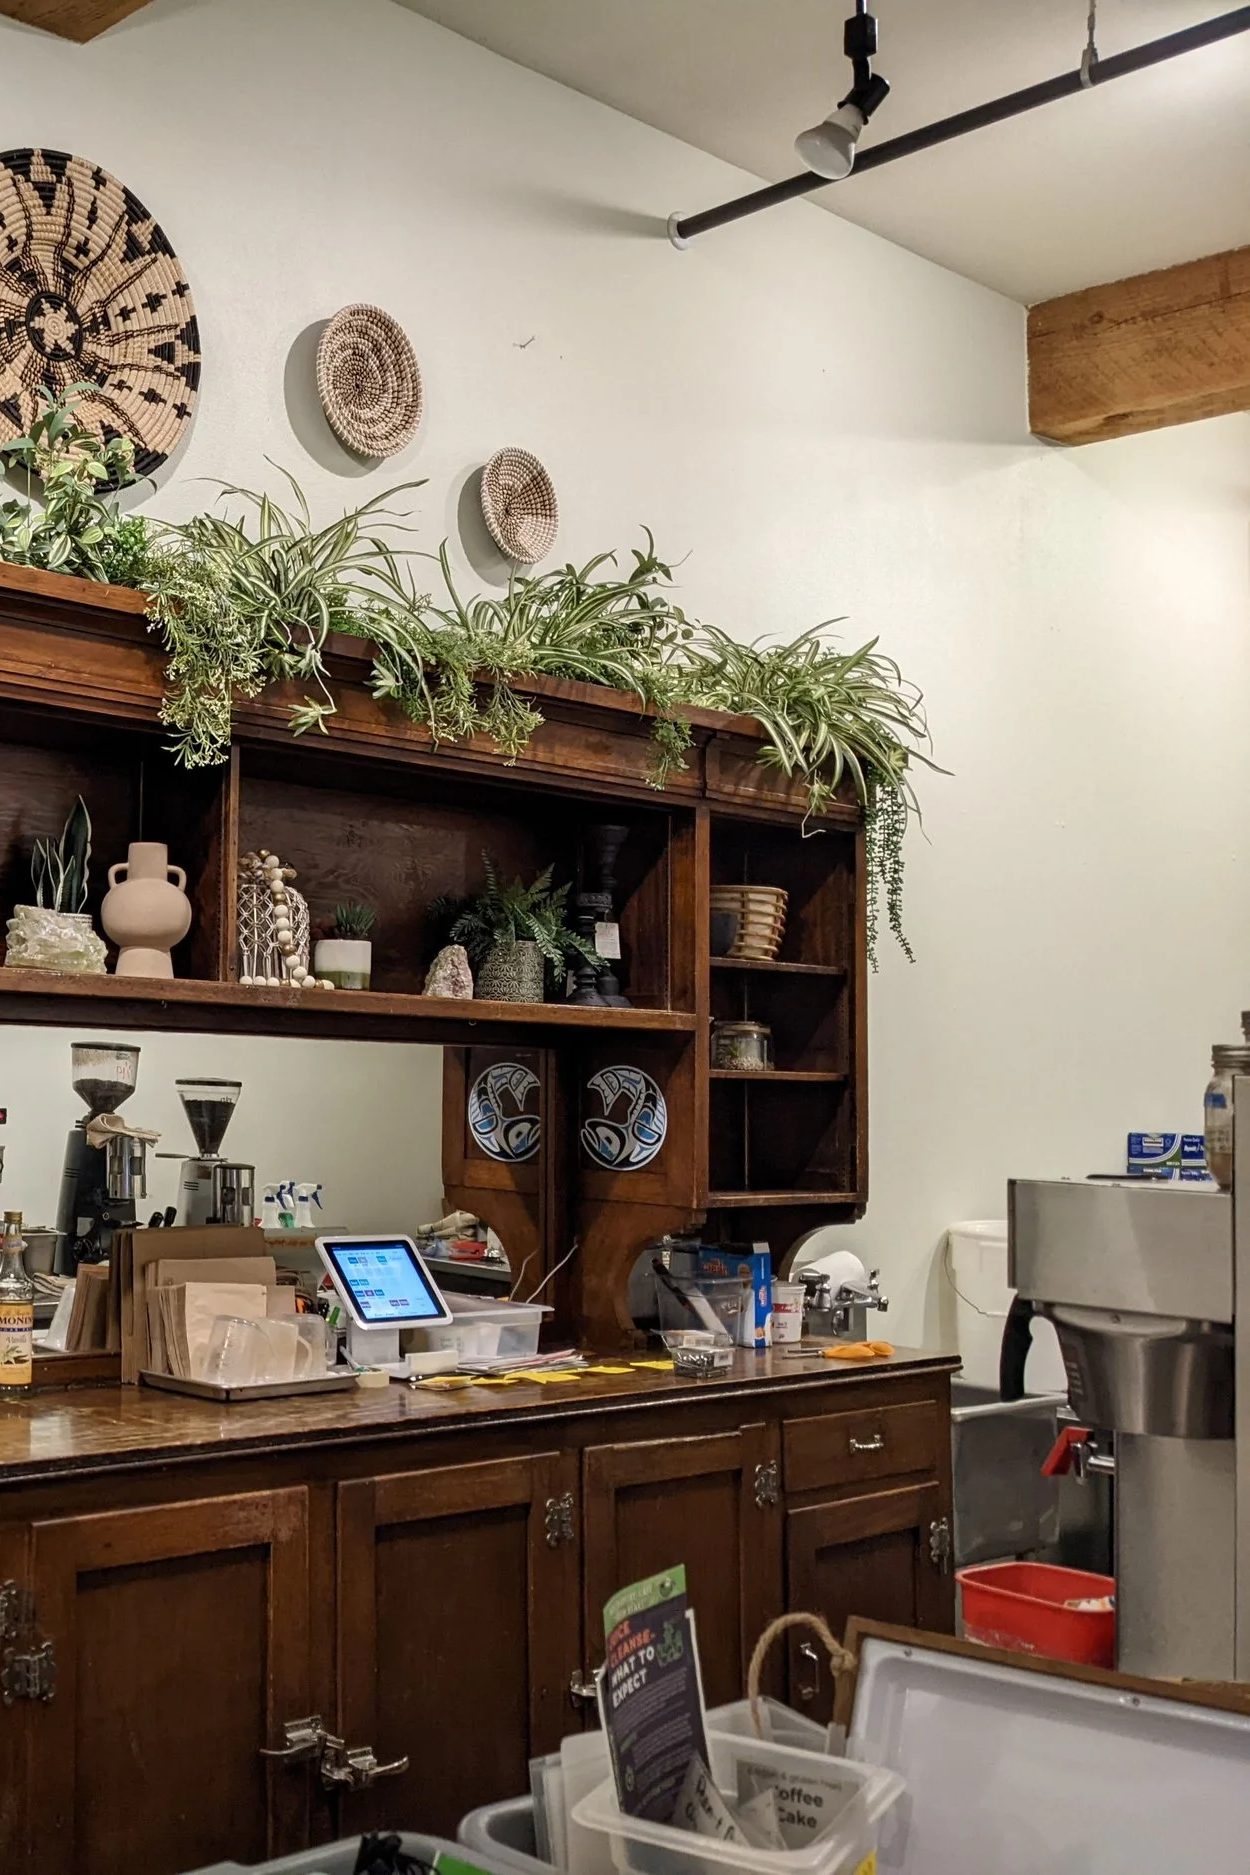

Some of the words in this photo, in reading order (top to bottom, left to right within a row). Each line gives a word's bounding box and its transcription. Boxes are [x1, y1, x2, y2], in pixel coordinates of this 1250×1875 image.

[611, 1655, 636, 1688] WHAT
[638, 1646, 655, 1666] TO
[612, 1668, 647, 1708] EXPECT
[774, 1784, 824, 1808] offee
